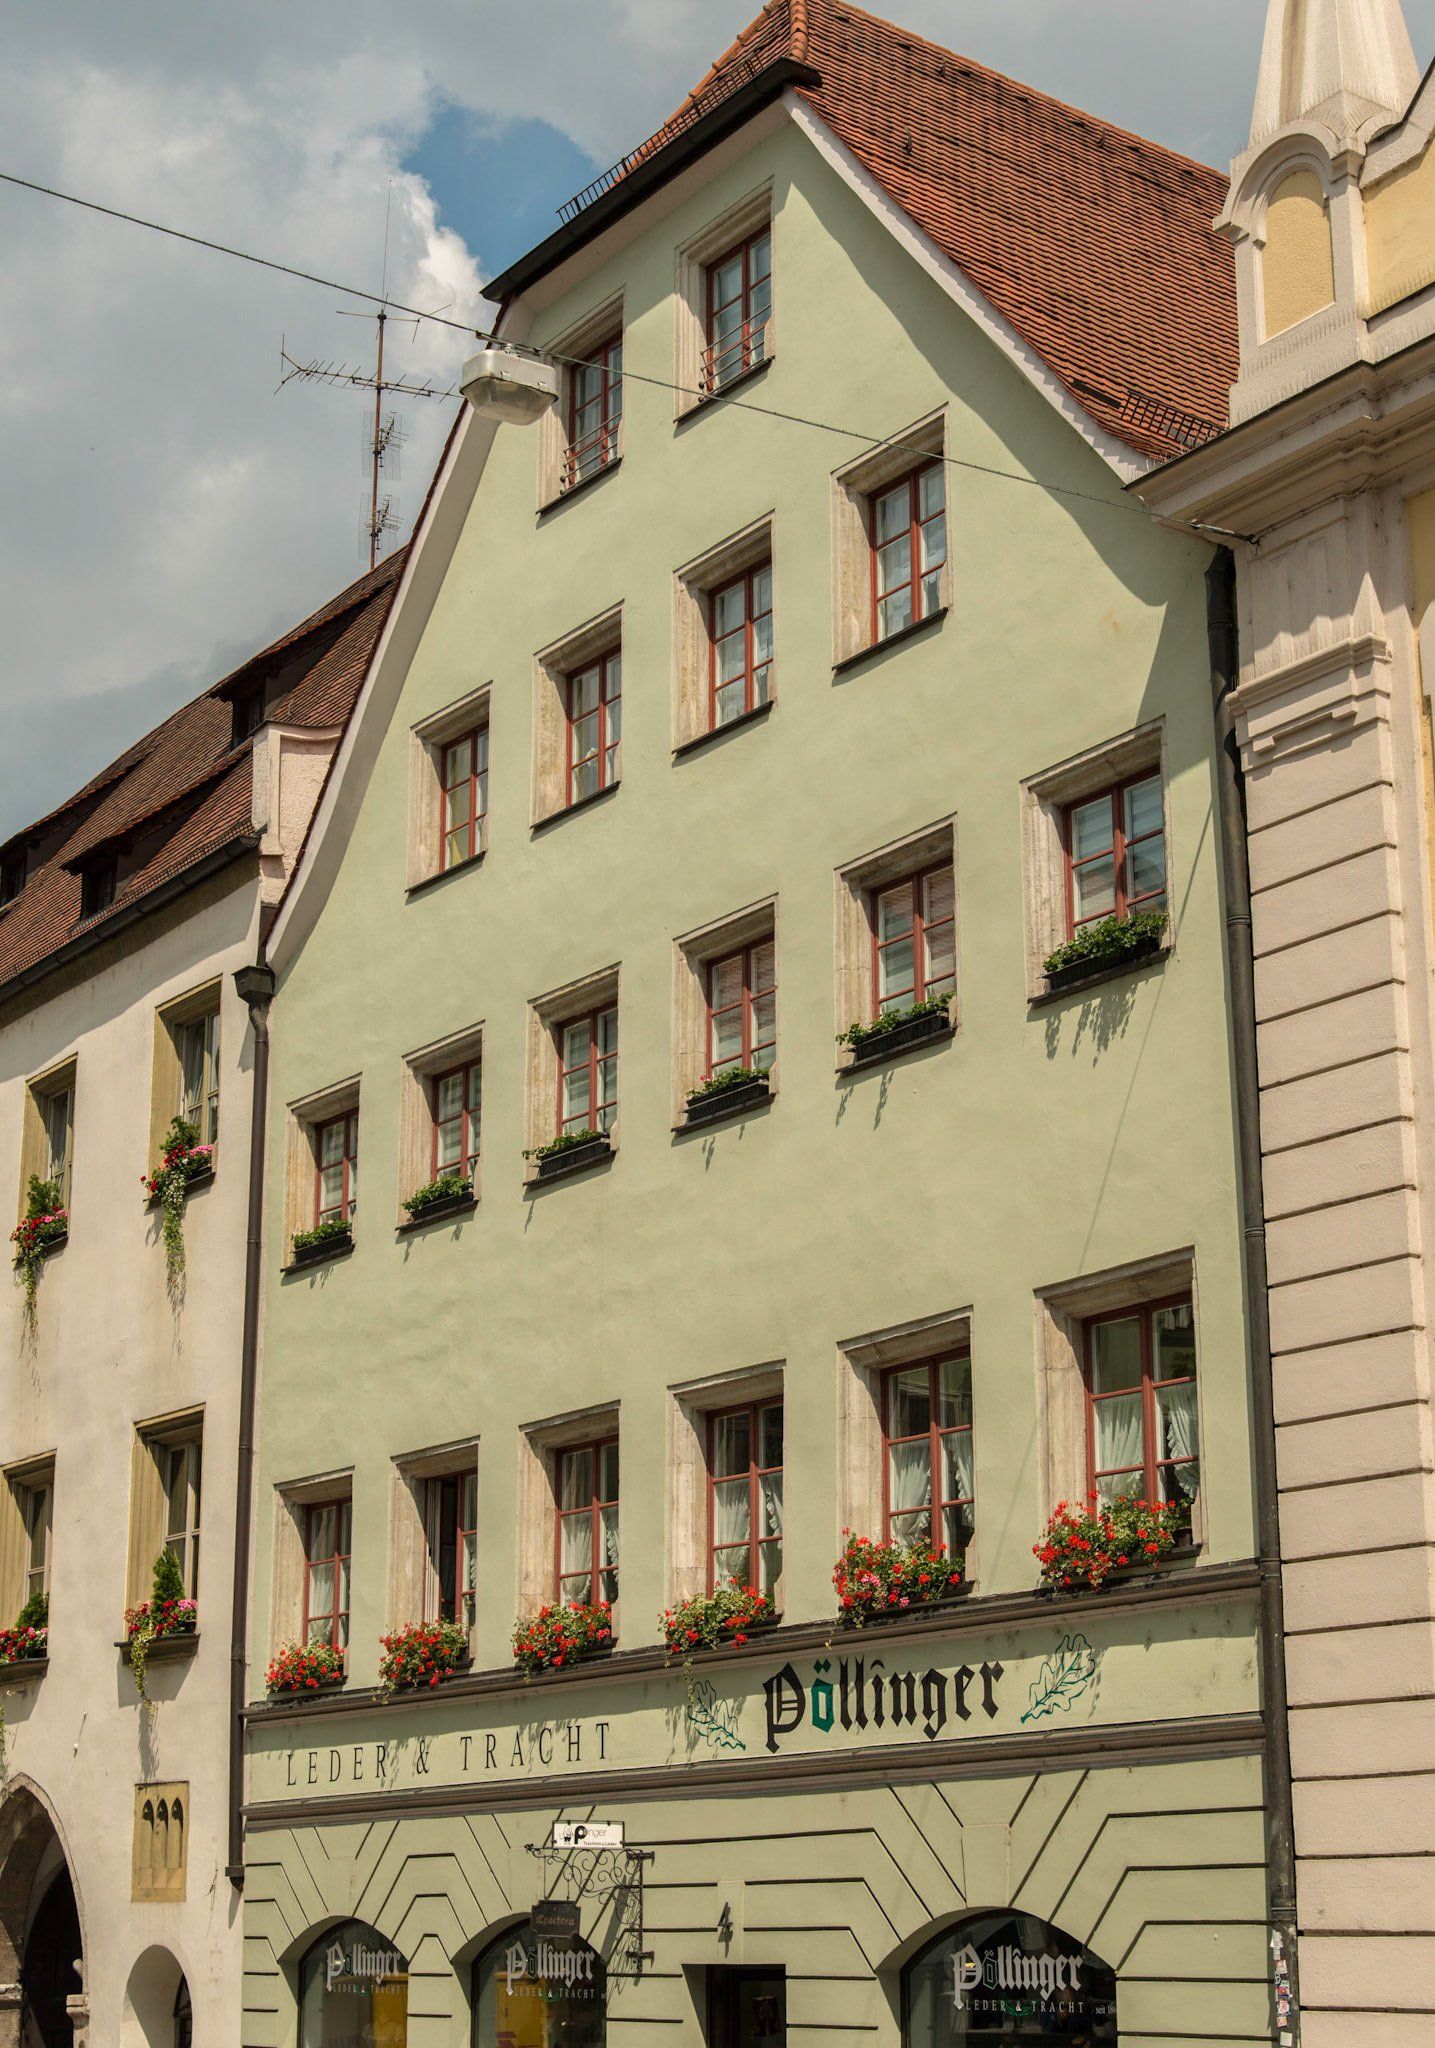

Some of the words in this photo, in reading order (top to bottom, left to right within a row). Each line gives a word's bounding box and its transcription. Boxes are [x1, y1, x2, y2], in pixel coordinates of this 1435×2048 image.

[762, 1655, 1005, 1754] Pöllinger
[287, 1744, 387, 1786] LEDER
[416, 1739, 429, 1774] &
[460, 1722, 609, 1771] TRACHT
[717, 1901, 733, 1941] 4
[514, 1987, 542, 1997] LEDER
[560, 1988, 595, 1999] TRACHT
[951, 1942, 1083, 2010] Pöllinger
[965, 2000, 1005, 2012] LEDER
[1015, 2001, 1022, 2012] &
[1032, 2001, 1084, 2014] TRACHT
